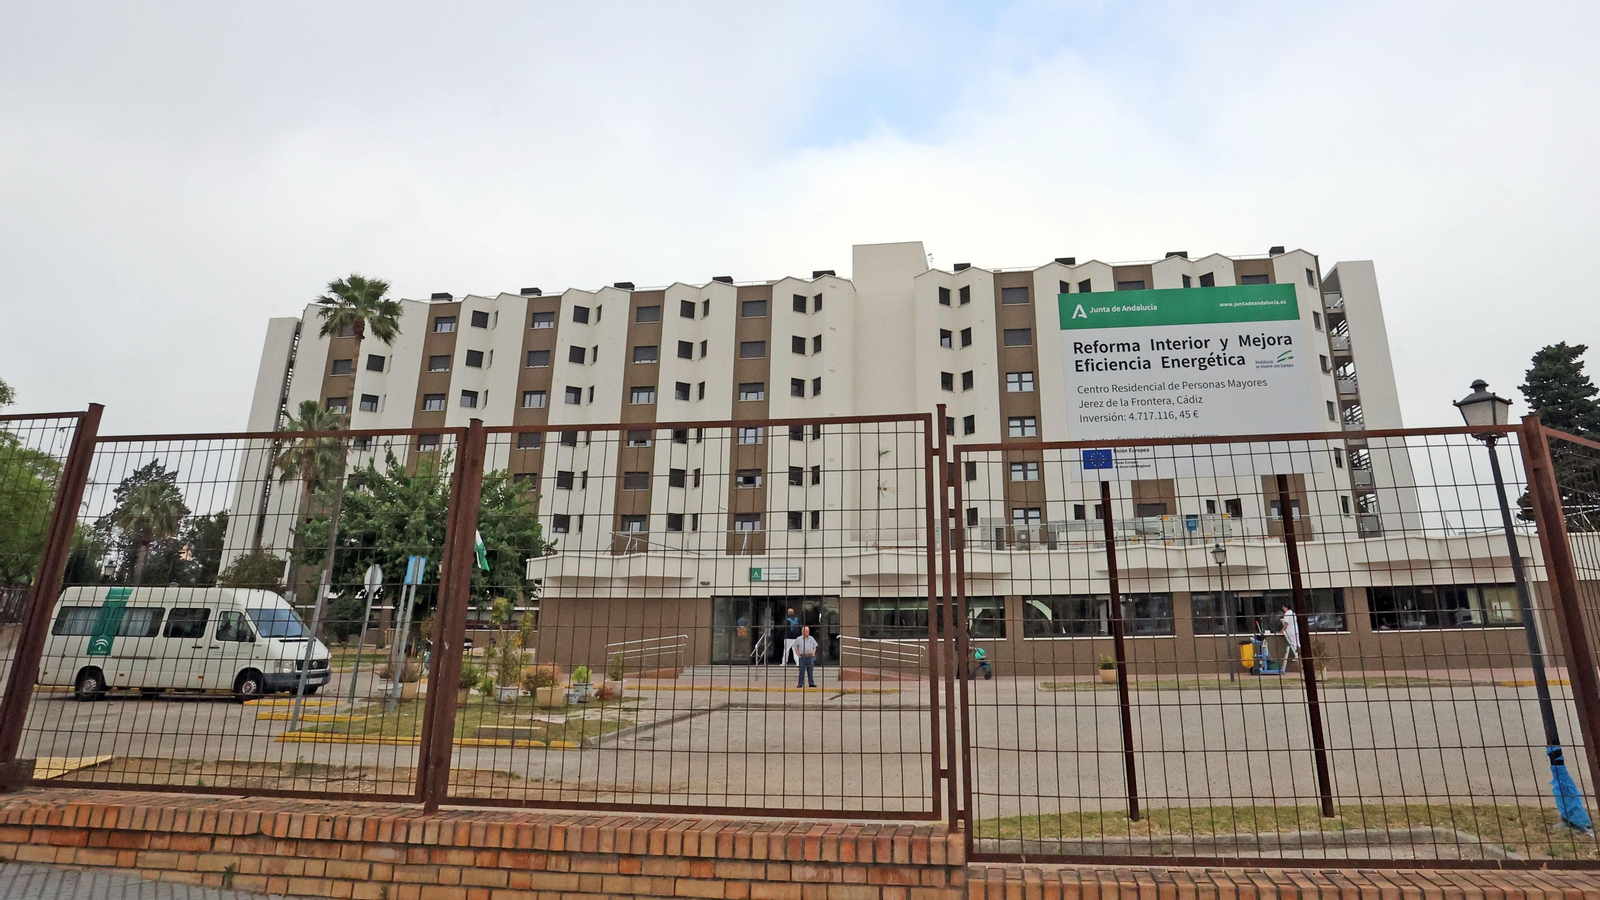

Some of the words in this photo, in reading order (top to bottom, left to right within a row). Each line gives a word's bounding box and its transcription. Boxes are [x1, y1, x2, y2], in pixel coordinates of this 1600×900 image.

[1089, 306, 1110, 314] Junta
[1121, 303, 1157, 312] Andalucía
[1073, 340, 1141, 354] Reforma
[1150, 336, 1210, 351] Interior
[1219, 338, 1228, 351] y
[1238, 333, 1293, 350] Mejora
[1075, 356, 1151, 372] Eficiencia
[1161, 352, 1246, 371] Energética
[1077, 385, 1110, 394] Centro
[1111, 381, 1166, 393] Residencial
[1167, 381, 1180, 391] de
[1181, 381, 1226, 390] Personas
[1227, 379, 1268, 390] Mayores
[1078, 399, 1104, 409] Jerez
[1106, 398, 1119, 408] de
[1120, 398, 1129, 407] la
[1131, 397, 1175, 406] Frontera,
[1176, 394, 1204, 405] Cádiz
[1079, 412, 1127, 423] Inversión:
[1128, 411, 1178, 421] 4.717.116,
[1179, 409, 1191, 419] 45
[1192, 409, 1200, 419] €
